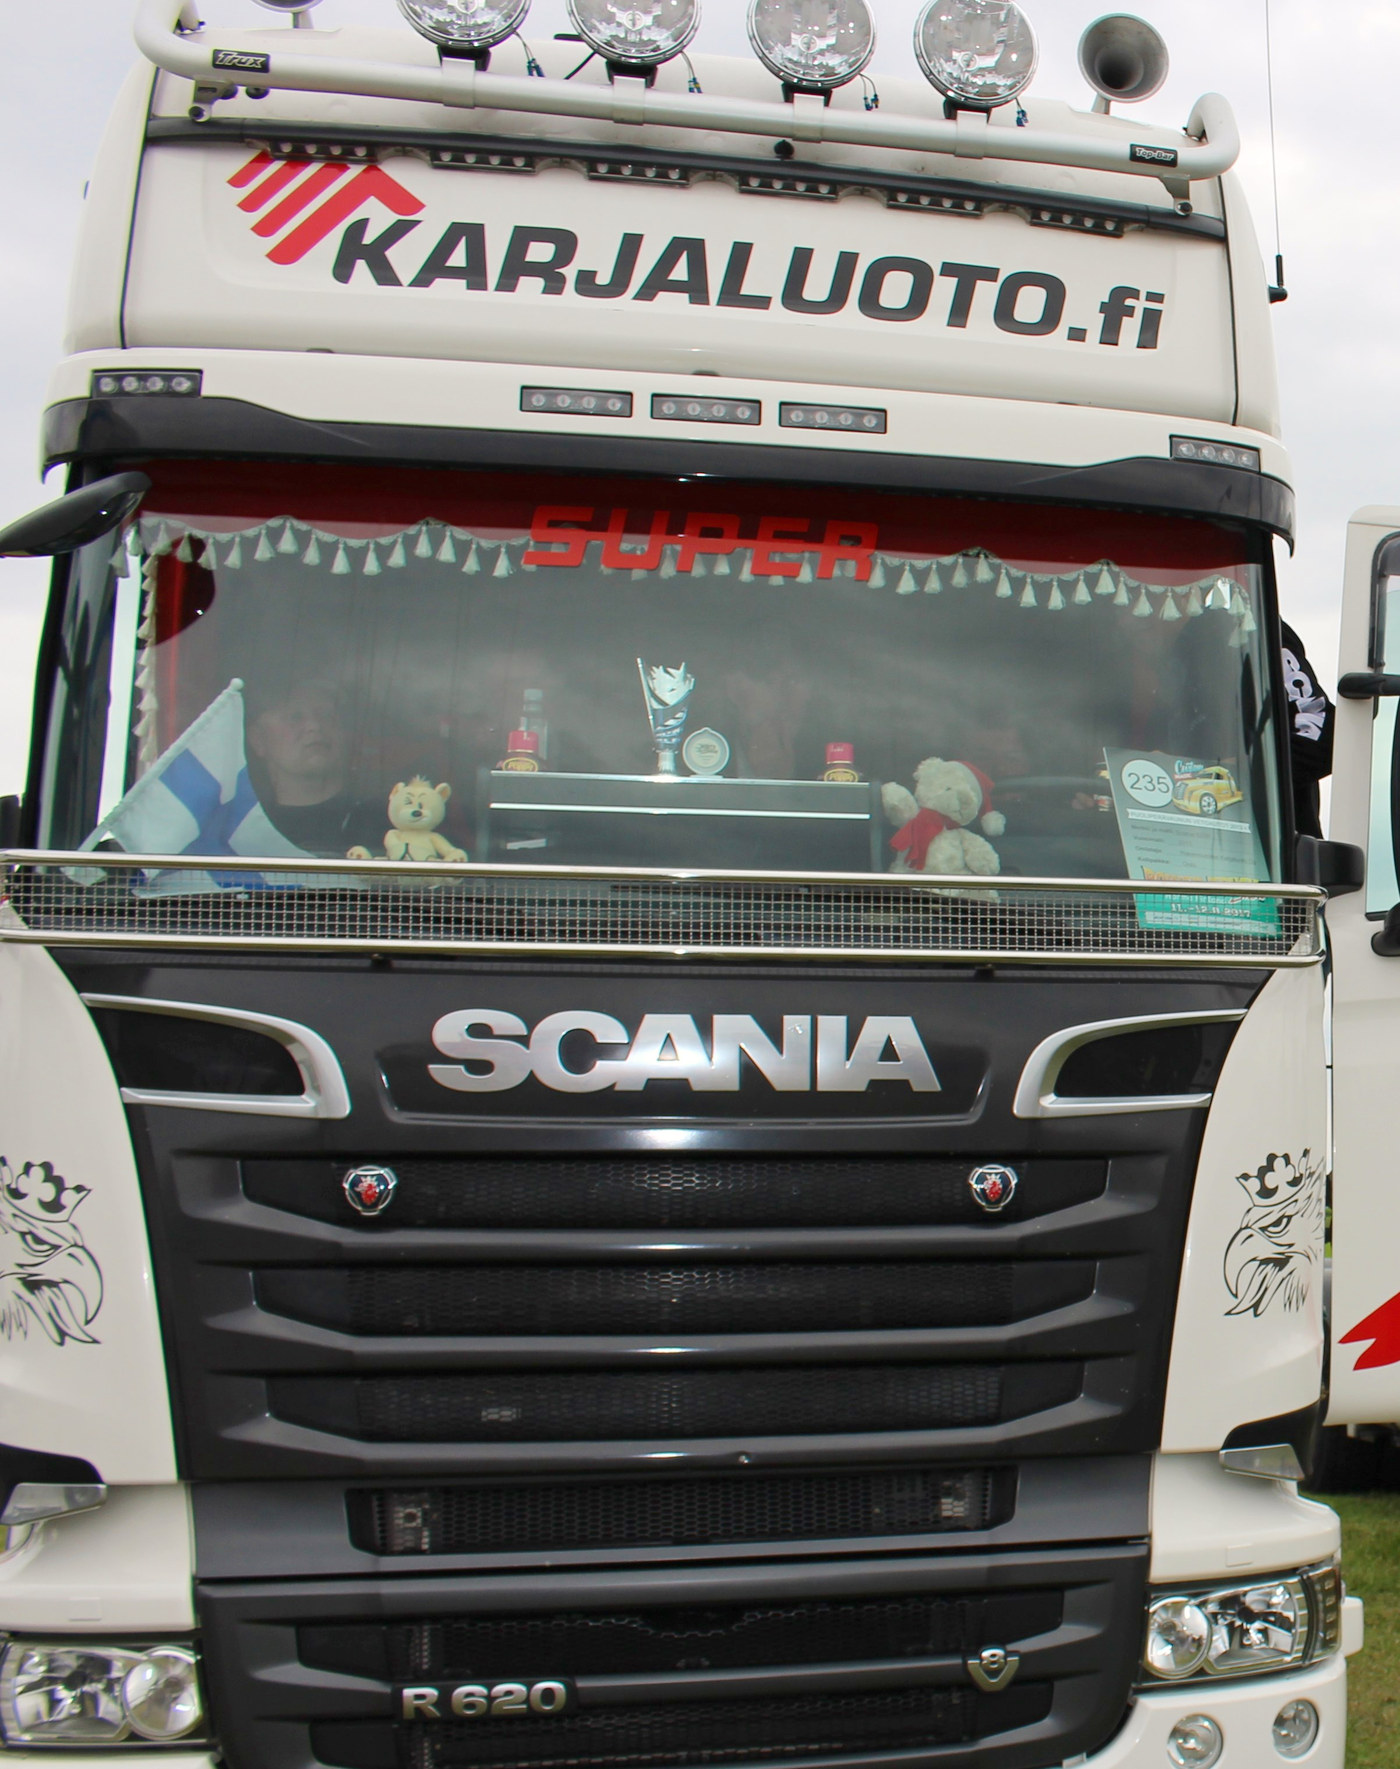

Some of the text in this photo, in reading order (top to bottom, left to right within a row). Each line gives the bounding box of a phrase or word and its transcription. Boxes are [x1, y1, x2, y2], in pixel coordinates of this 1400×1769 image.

[215, 51, 266, 68] Trux
[1135, 147, 1175, 161] Top-Bar
[332, 217, 1166, 349] KARJALUOTO.fi
[522, 505, 880, 582] SUPER
[1127, 772, 1170, 794] 235
[426, 1008, 942, 1093] SCANIA
[402, 1680, 567, 1720] R 620
